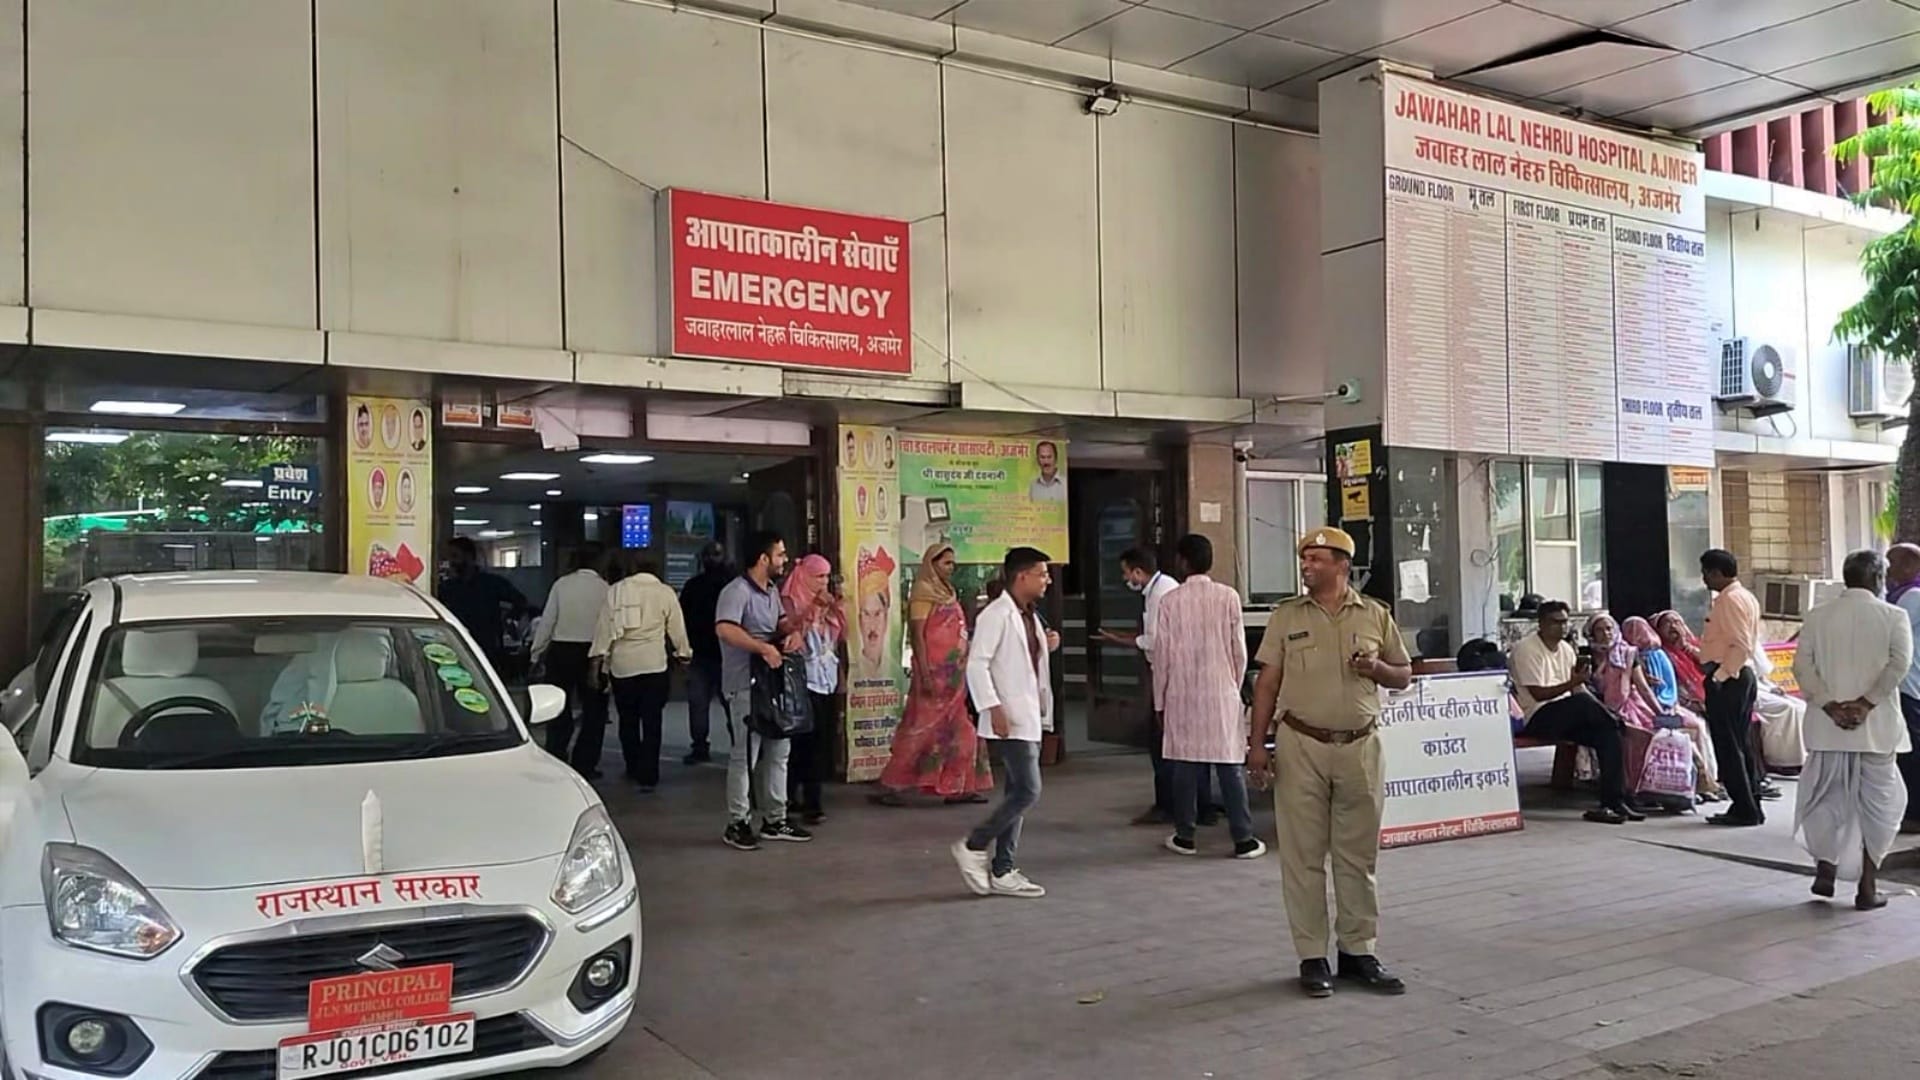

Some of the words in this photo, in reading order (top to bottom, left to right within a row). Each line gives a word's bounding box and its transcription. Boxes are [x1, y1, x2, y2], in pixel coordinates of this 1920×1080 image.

[1395, 90, 1481, 135] JAWAHAR
[1487, 112, 1516, 142] LAL
[1521, 120, 1573, 156] NEHRU
[1579, 134, 1647, 175] HOSPITAL
[1651, 153, 1698, 186] AJMER
[1389, 174, 1425, 196] GROUND
[1428, 182, 1454, 202] FLOOR
[1414, 136, 1468, 168] जवाहर
[1471, 149, 1507, 176] लाल
[1548, 160, 1634, 209] चिकित्सालय,
[1638, 186, 1682, 214] अजमेर
[1513, 199, 1534, 218] FIRST
[1536, 203, 1560, 223] FLOOR
[686, 217, 838, 266] आपातकालीन
[1615, 226, 1641, 246] SECOND
[1643, 232, 1663, 250] FLOOR
[691, 267, 892, 319] EMERGENCY
[683, 316, 756, 343] जवाहरलाल
[788, 320, 863, 356] चिकित्सालय,
[866, 330, 902, 356] अजमेर
[268, 485, 313, 504] Entry
[1473, 695, 1500, 717] चेयर
[1421, 732, 1468, 757] काउंटर
[1384, 768, 1473, 798] आपातकालीन
[1476, 763, 1510, 790] इकाई
[256, 880, 381, 919] राजस्थान
[393, 874, 484, 901] सरकार
[321, 971, 443, 1004] PRINCIPAL
[315, 1004, 340, 1019] JLN
[342, 996, 394, 1014] MEDICAL
[395, 991, 447, 1007] COLLEGE
[303, 1022, 468, 1070] RJ01CD6102
